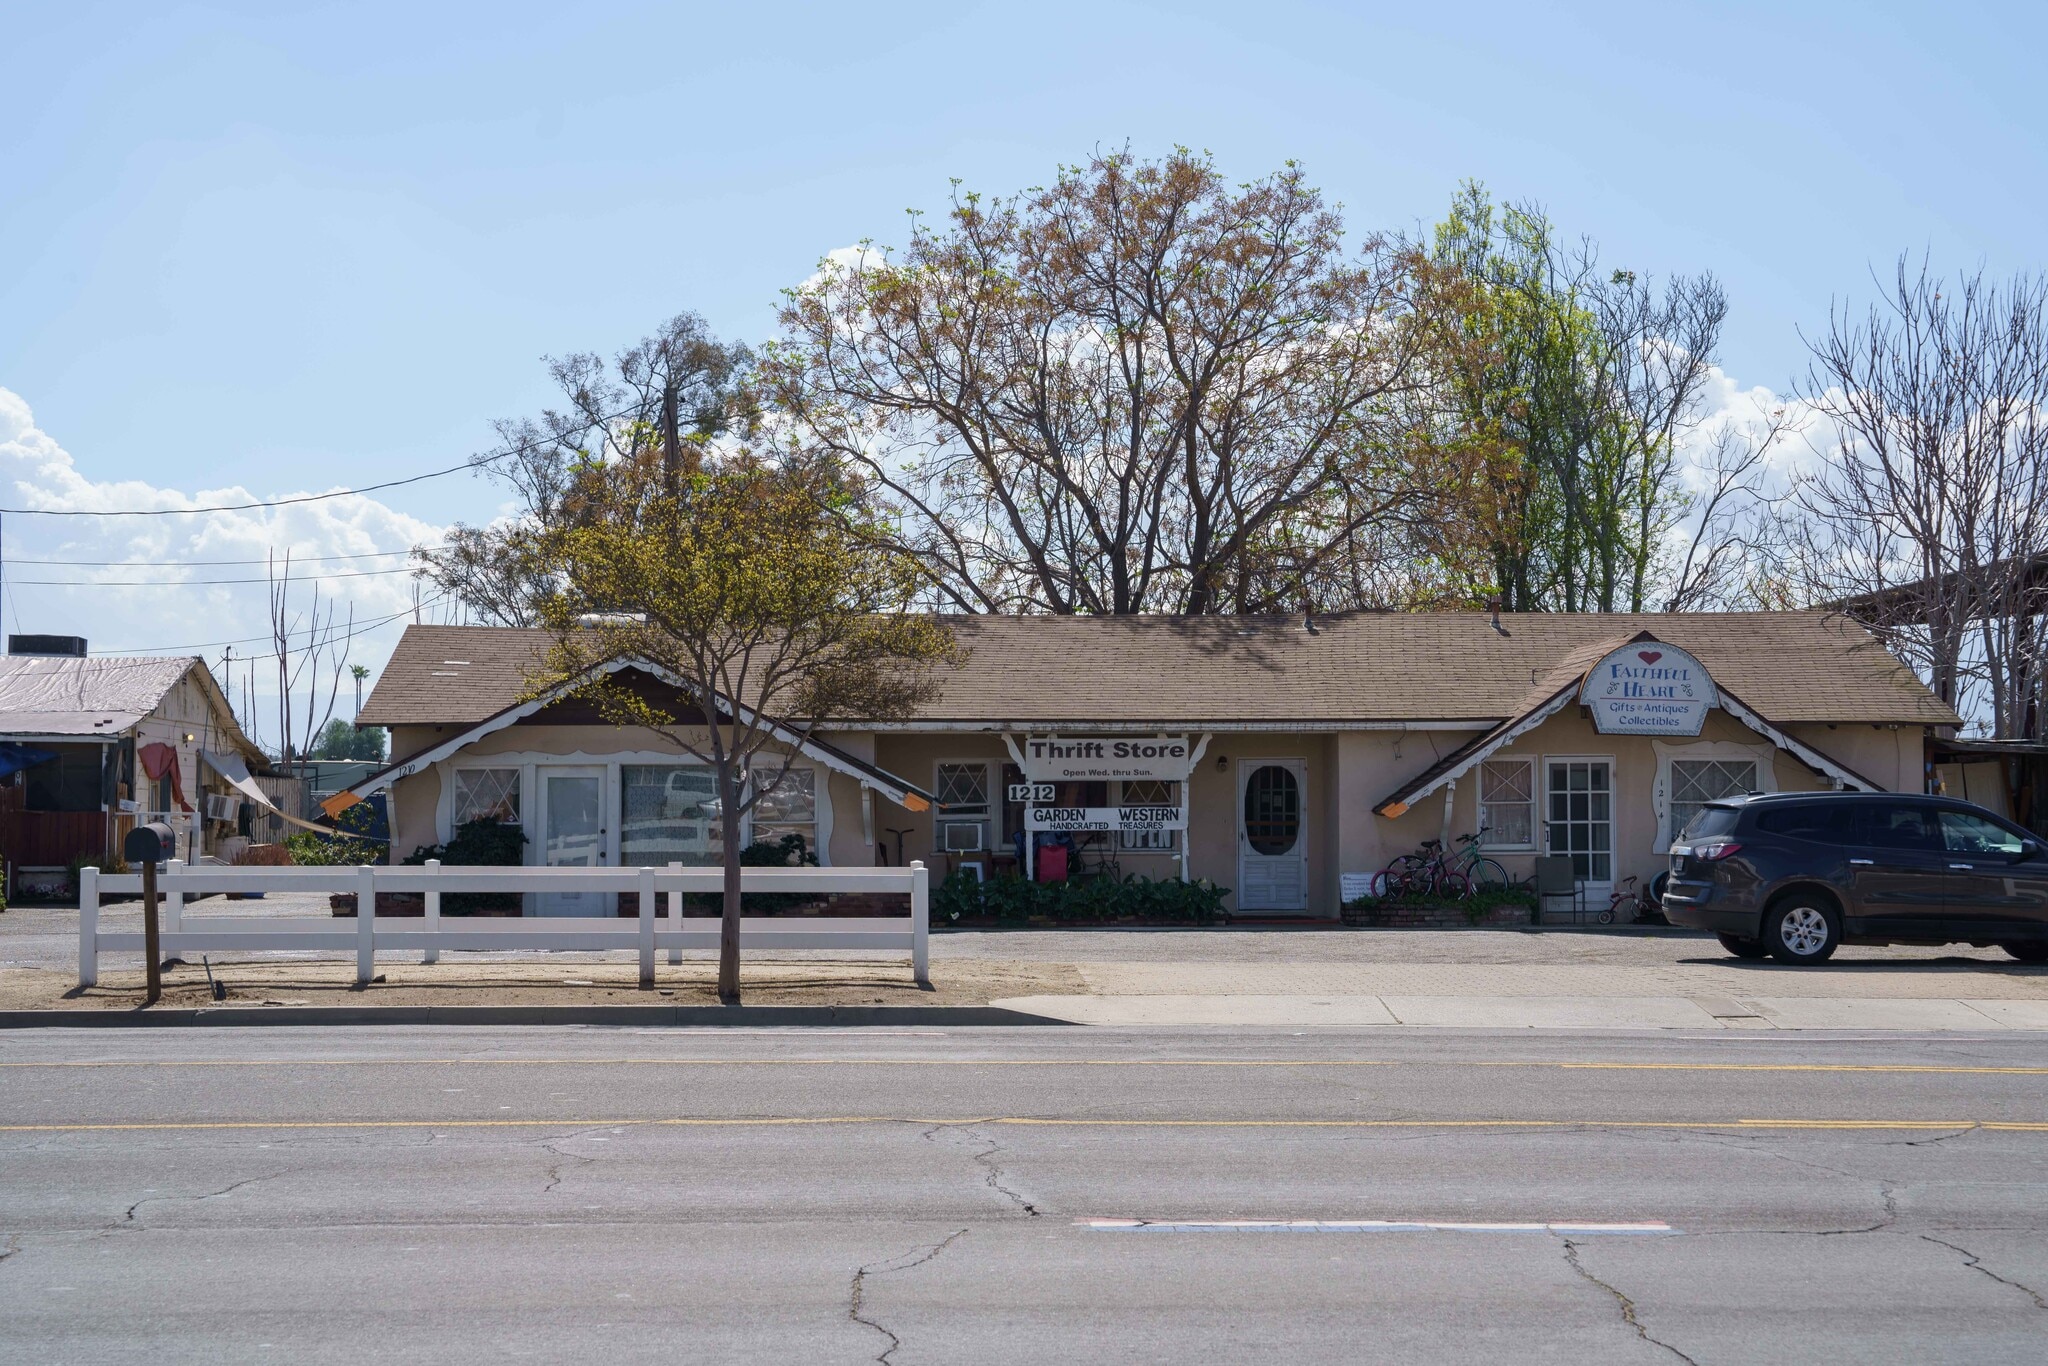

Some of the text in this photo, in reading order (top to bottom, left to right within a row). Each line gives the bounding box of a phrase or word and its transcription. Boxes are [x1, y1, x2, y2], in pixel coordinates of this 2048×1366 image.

[1611, 663, 1691, 681] FAITHFUL
[1623, 682, 1677, 698] HEART
[1610, 702, 1689, 715] Gifts Antiques
[1619, 716, 1680, 726] Collectibles
[1029, 742, 1185, 758] Thrift Store
[1063, 769, 1086, 777] Open
[1010, 786, 1054, 800] 1212
[1034, 808, 1179, 822] GARDEN WESTERN
[1050, 822, 1109, 830] HANDCRAFTED
[1123, 830, 1171, 848] OPEN
